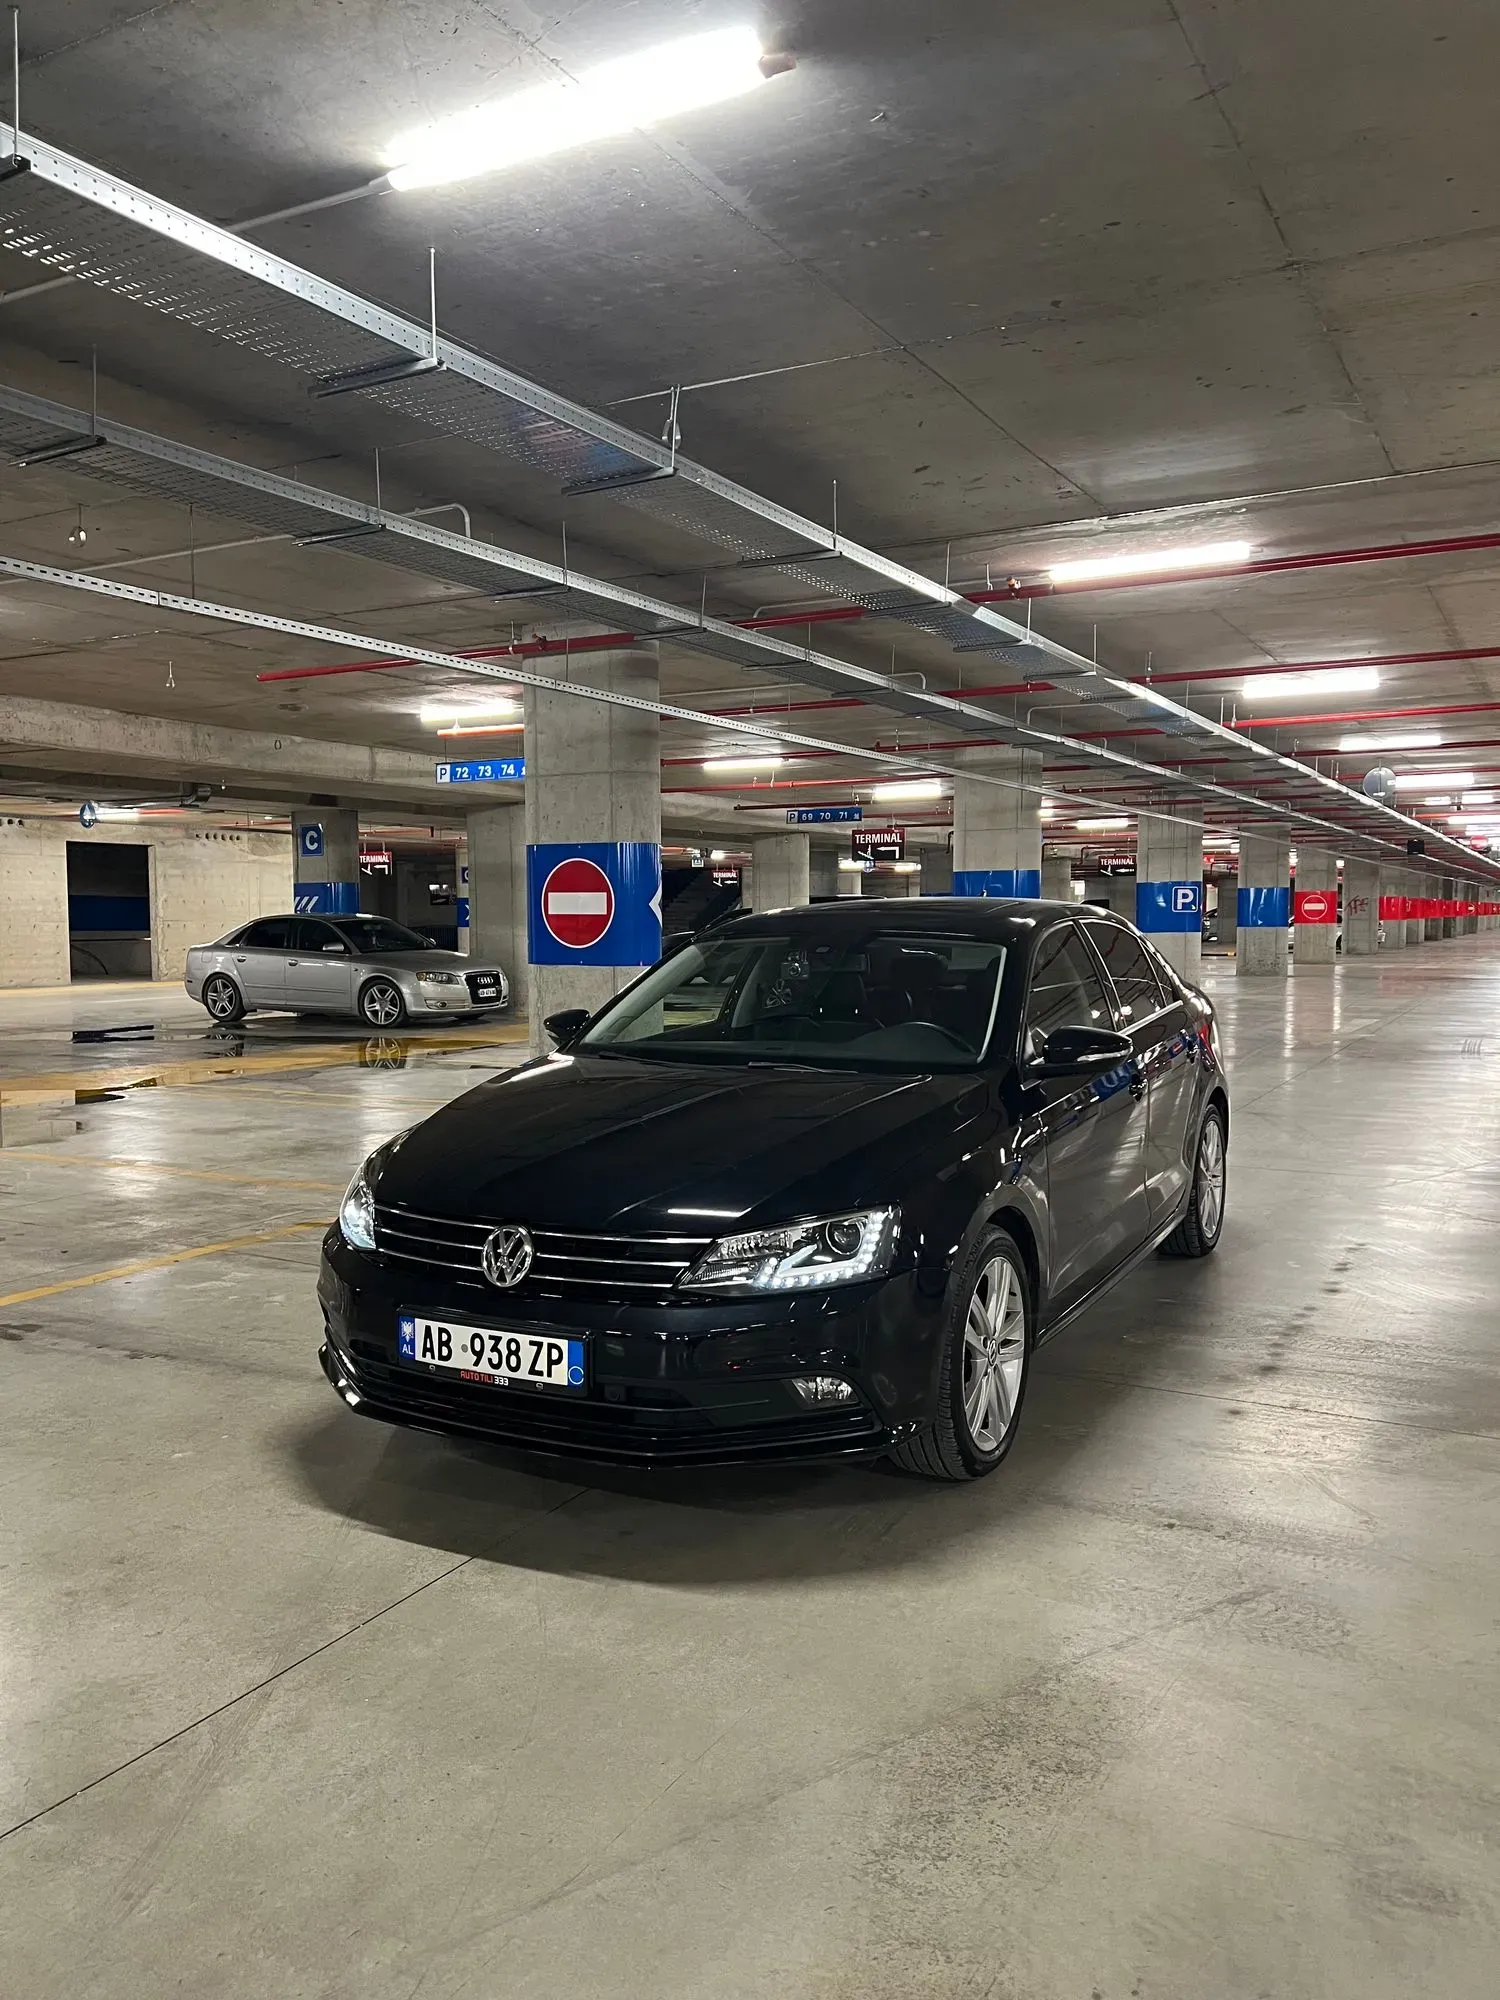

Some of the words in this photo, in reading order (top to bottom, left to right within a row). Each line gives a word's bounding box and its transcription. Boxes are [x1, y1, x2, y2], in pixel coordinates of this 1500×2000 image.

[439, 767, 447, 780] P
[455, 766, 469, 779] 72
[478, 765, 492, 777] 73
[501, 763, 515, 776] 74
[789, 812, 796, 822] P
[801, 813, 813, 821] 69
[819, 812, 831, 820] 70
[839, 811, 848, 819] 71
[305, 830, 319, 851] C
[855, 832, 903, 844] TERMINAL
[359, 855, 390, 863] TERMINAL
[1100, 858, 1135, 866] TERMINAL
[1176, 888, 1194, 910] P
[402, 1344, 414, 1355] AL
[421, 1325, 453, 1362] AB
[469, 1332, 522, 1373] 938
[528, 1340, 564, 1378] ZP
[494, 1375, 509, 1386] 333
